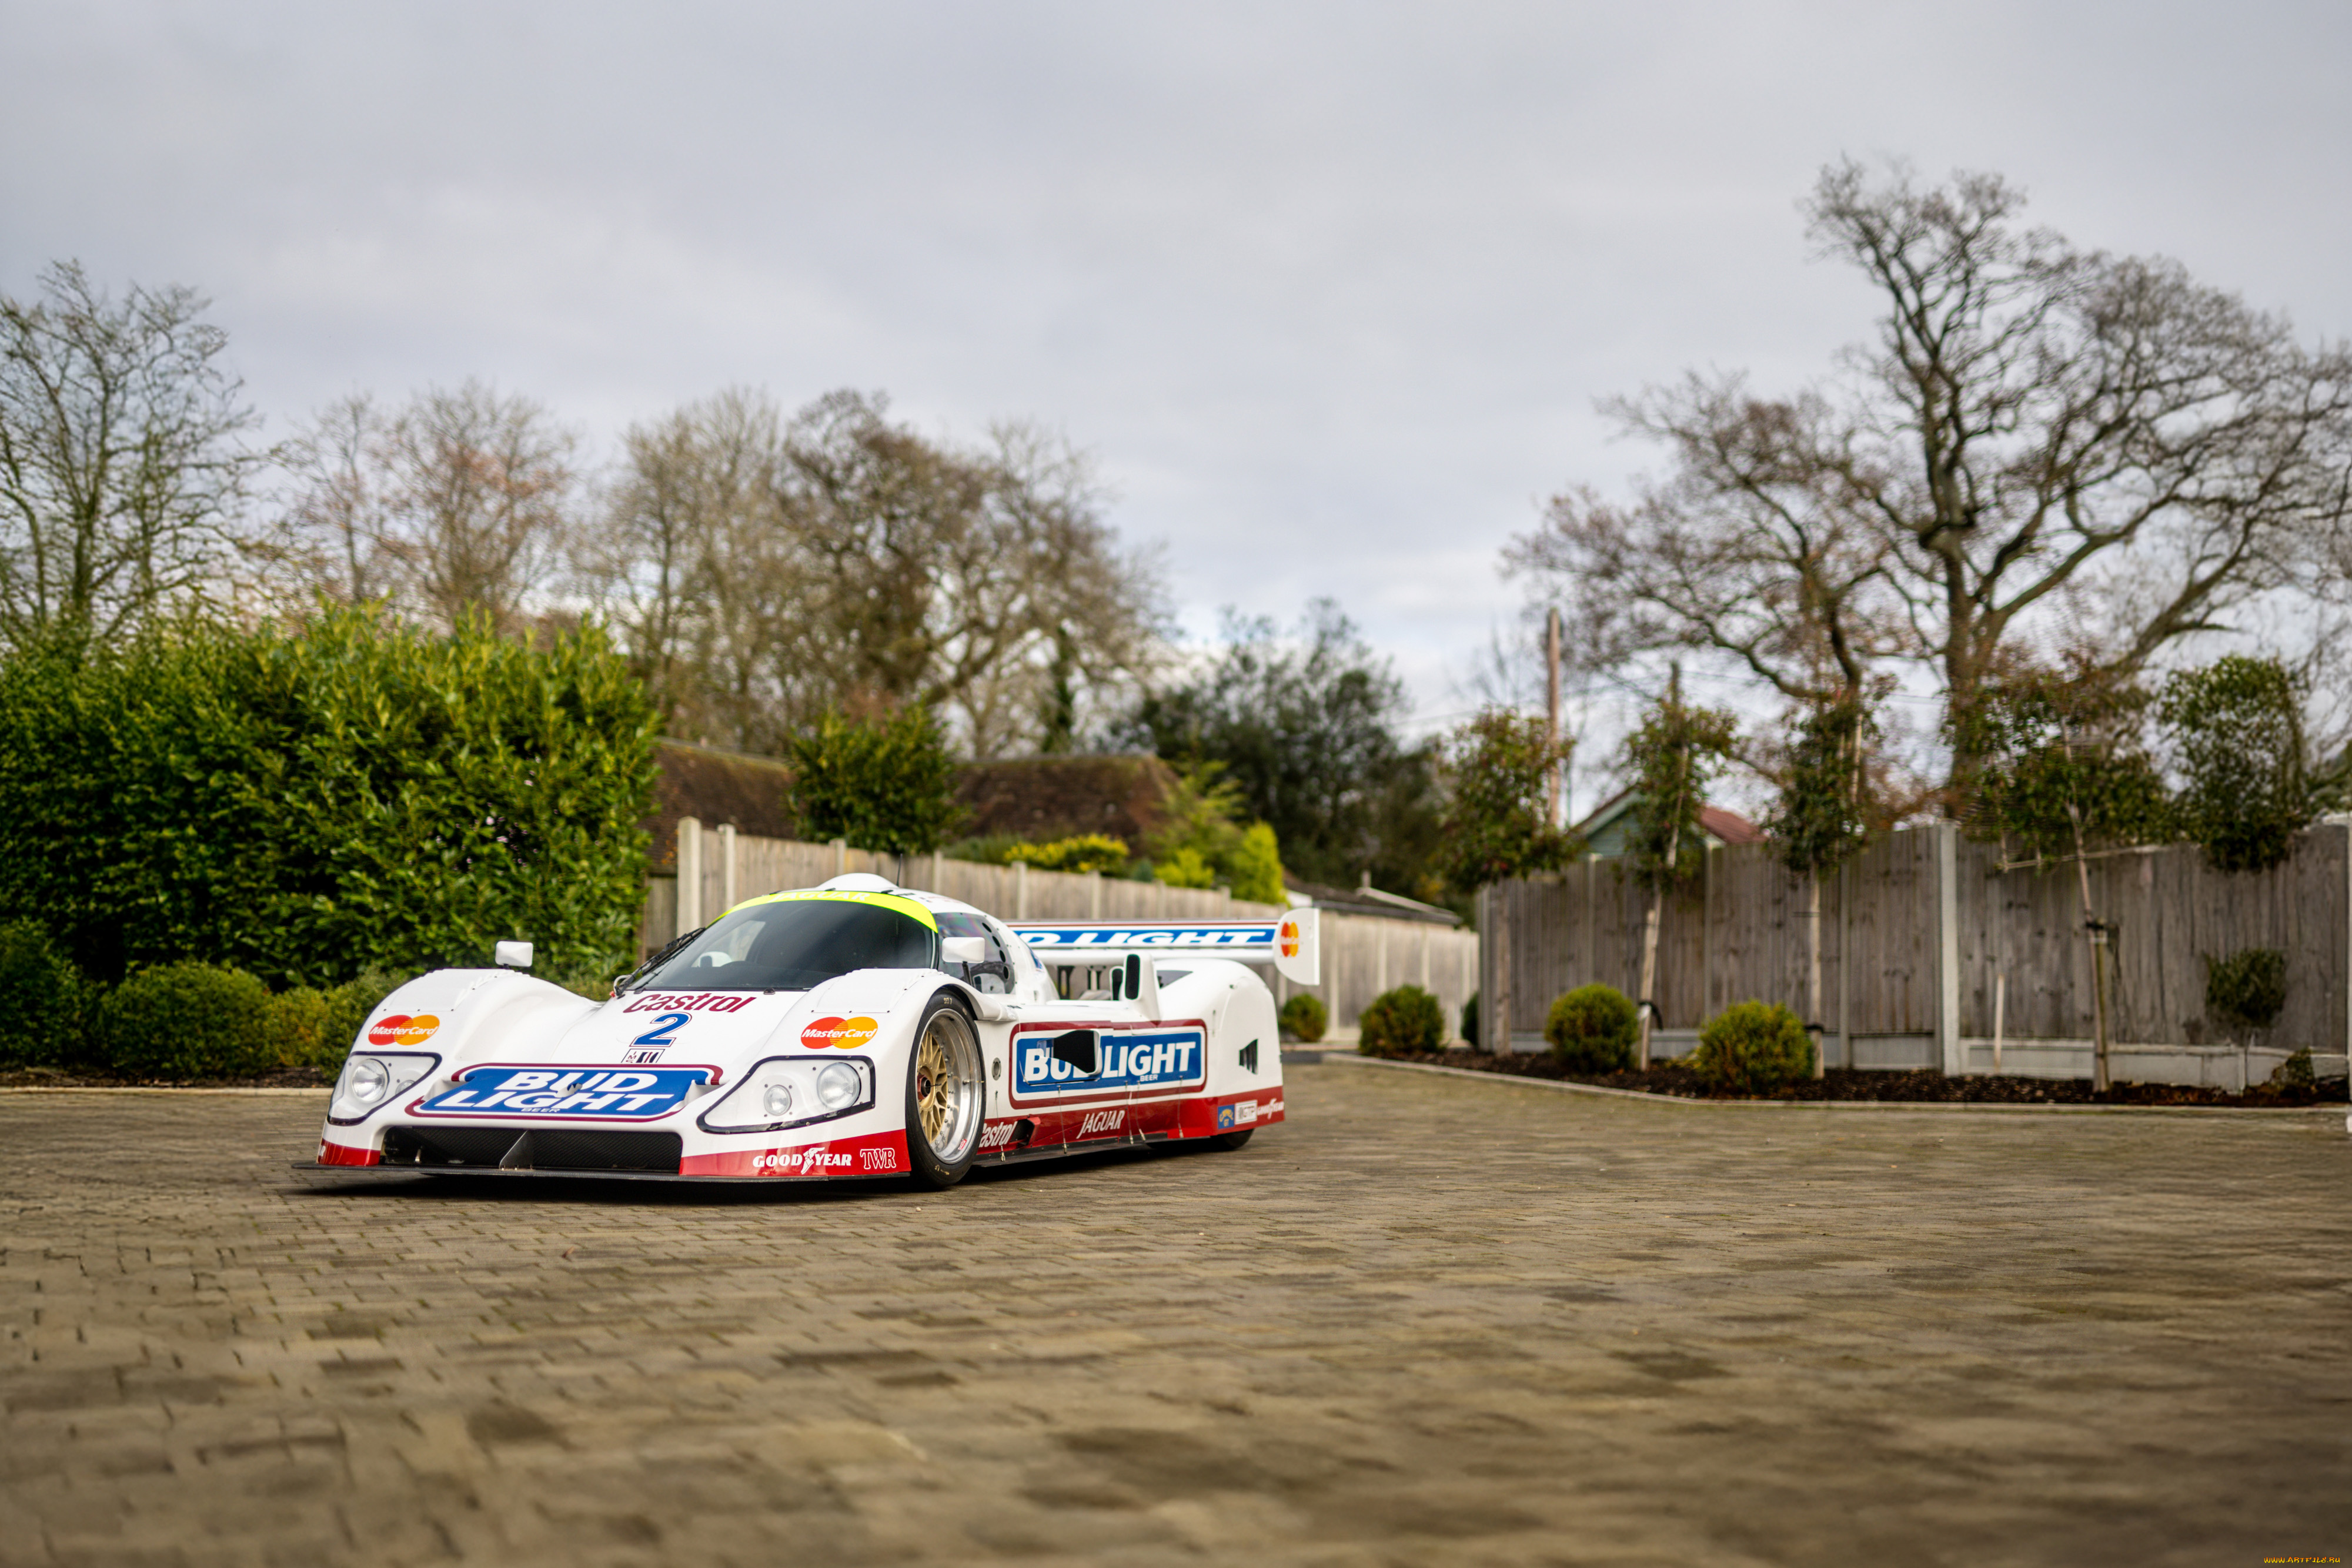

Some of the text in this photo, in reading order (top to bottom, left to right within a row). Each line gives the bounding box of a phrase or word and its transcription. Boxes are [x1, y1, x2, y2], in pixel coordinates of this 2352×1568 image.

[767, 891, 871, 902] JAGUAR
[1072, 931, 1266, 944] LIGHT
[623, 993, 757, 1013] Castrol
[370, 1027, 439, 1035] MasterCard
[629, 1012, 692, 1047] 2
[801, 1028, 877, 1038] MasterCard
[1101, 1042, 1196, 1078] LIGHT
[493, 1072, 658, 1092] BUD
[1140, 1074, 1158, 1082] BEER
[435, 1091, 674, 1111] LIGHT
[1076, 1110, 1125, 1139] JAGUAR
[860, 1148, 897, 1170] TWR
